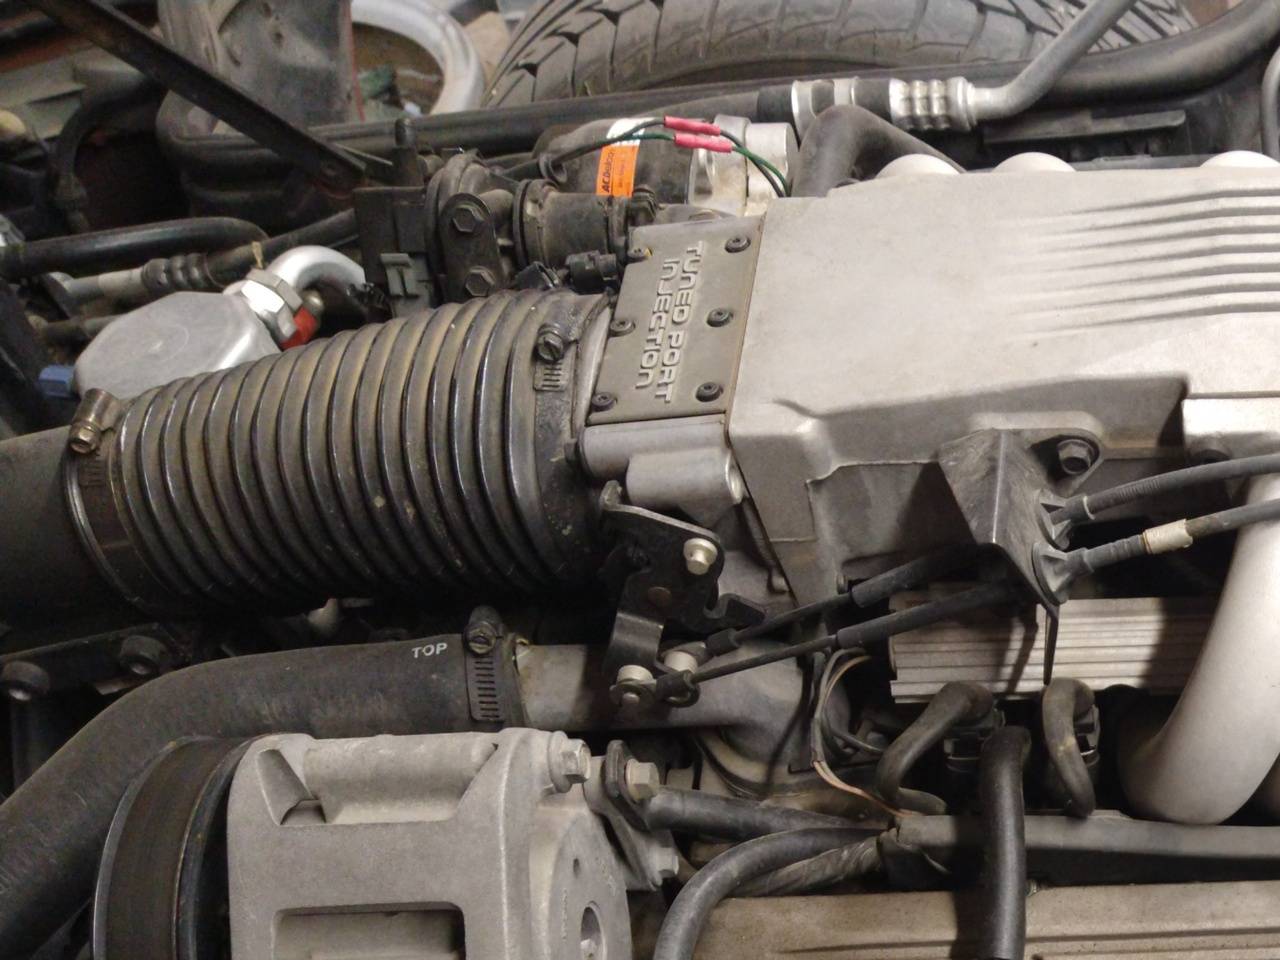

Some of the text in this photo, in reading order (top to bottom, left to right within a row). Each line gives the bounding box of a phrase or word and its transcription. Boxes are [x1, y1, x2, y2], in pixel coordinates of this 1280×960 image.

[635, 259, 680, 390] INJECTION
[656, 240, 703, 403] TUNED PORT
[411, 642, 448, 659] TOP
